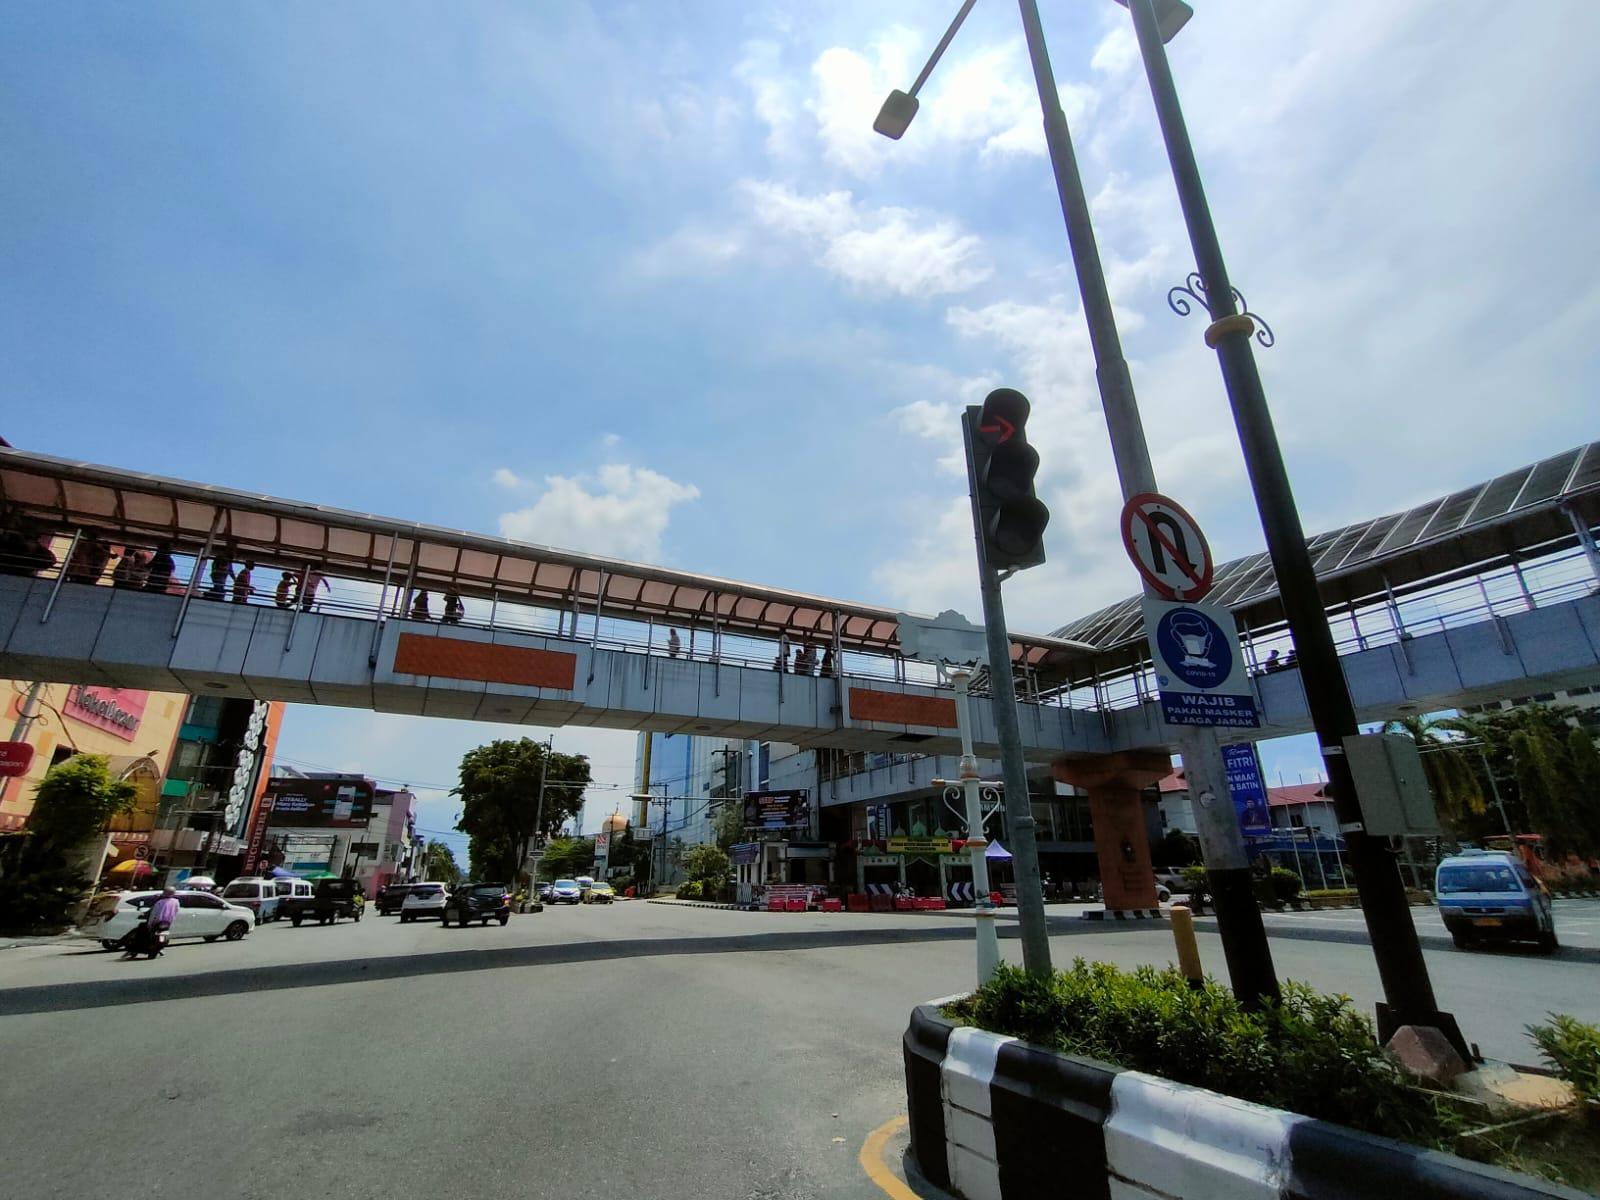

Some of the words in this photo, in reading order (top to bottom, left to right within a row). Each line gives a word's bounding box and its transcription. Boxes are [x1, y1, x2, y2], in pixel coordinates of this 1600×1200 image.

[1186, 670, 1216, 678] COVID-19
[1181, 695, 1235, 707] WAJIB
[1167, 706, 1202, 714] PAKAI
[1205, 709, 1254, 717] MASKER
[1182, 716, 1213, 725] JAGA
[1215, 717, 1254, 726] JARAK
[1227, 756, 1254, 768] FITRI
[1234, 773, 1256, 782] MAAF
[1236, 781, 1259, 791] BATIN
